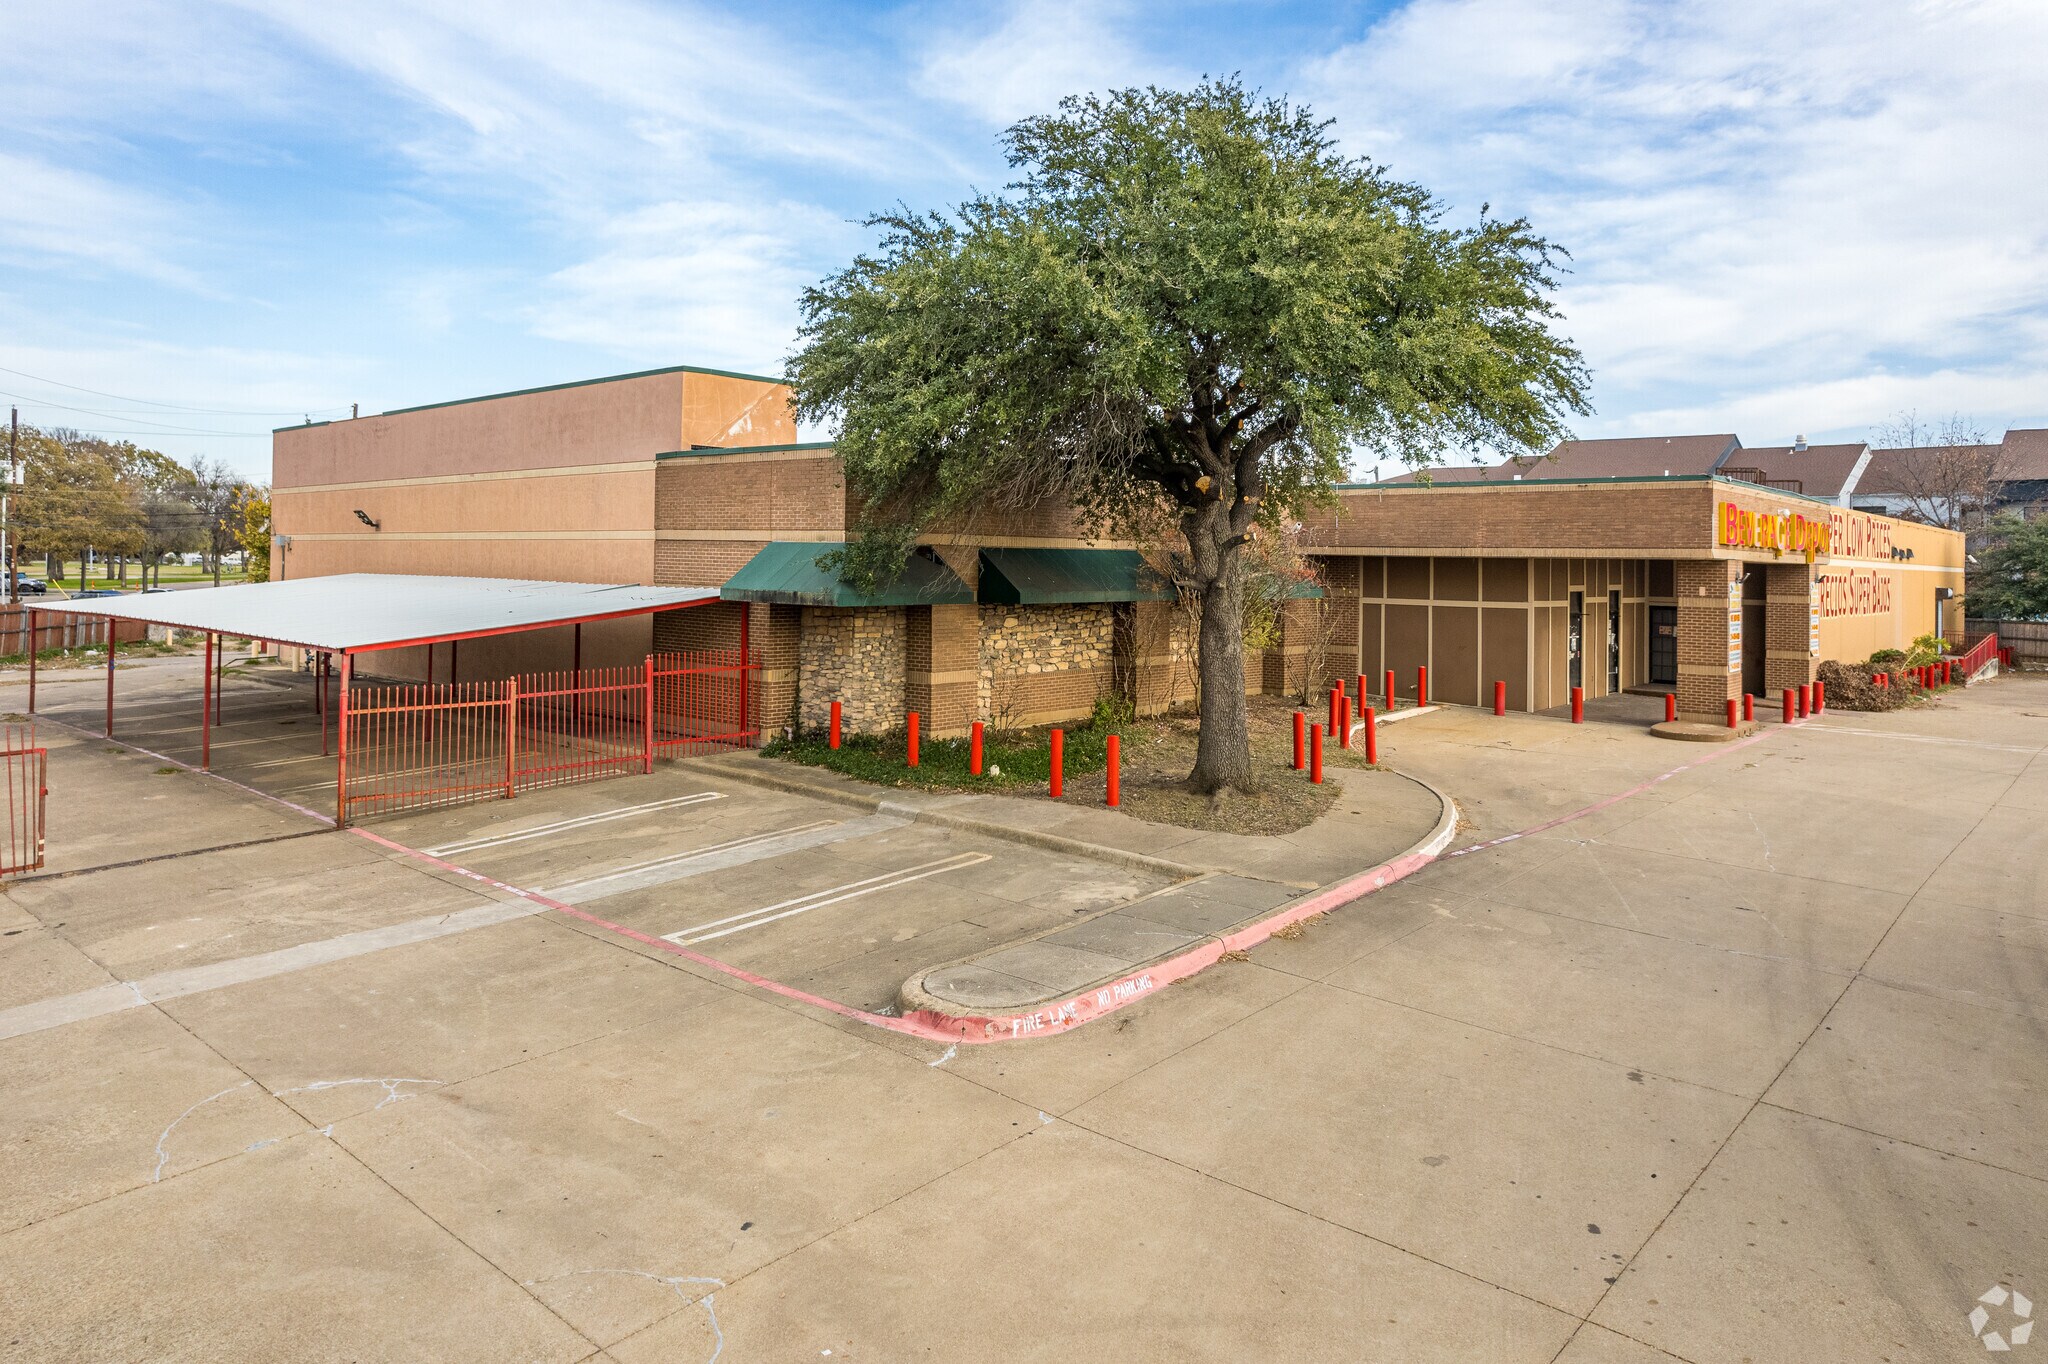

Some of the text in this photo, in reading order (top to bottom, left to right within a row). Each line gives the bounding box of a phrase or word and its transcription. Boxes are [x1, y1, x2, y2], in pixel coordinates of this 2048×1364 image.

[1846, 512, 1864, 557] LOW
[1867, 516, 1891, 559] PRICES
[1849, 568, 1871, 615] SUPER
[1872, 570, 1891, 613] BAJOS
[1012, 975, 1153, 1038] FIRE LANE NO PARKING
